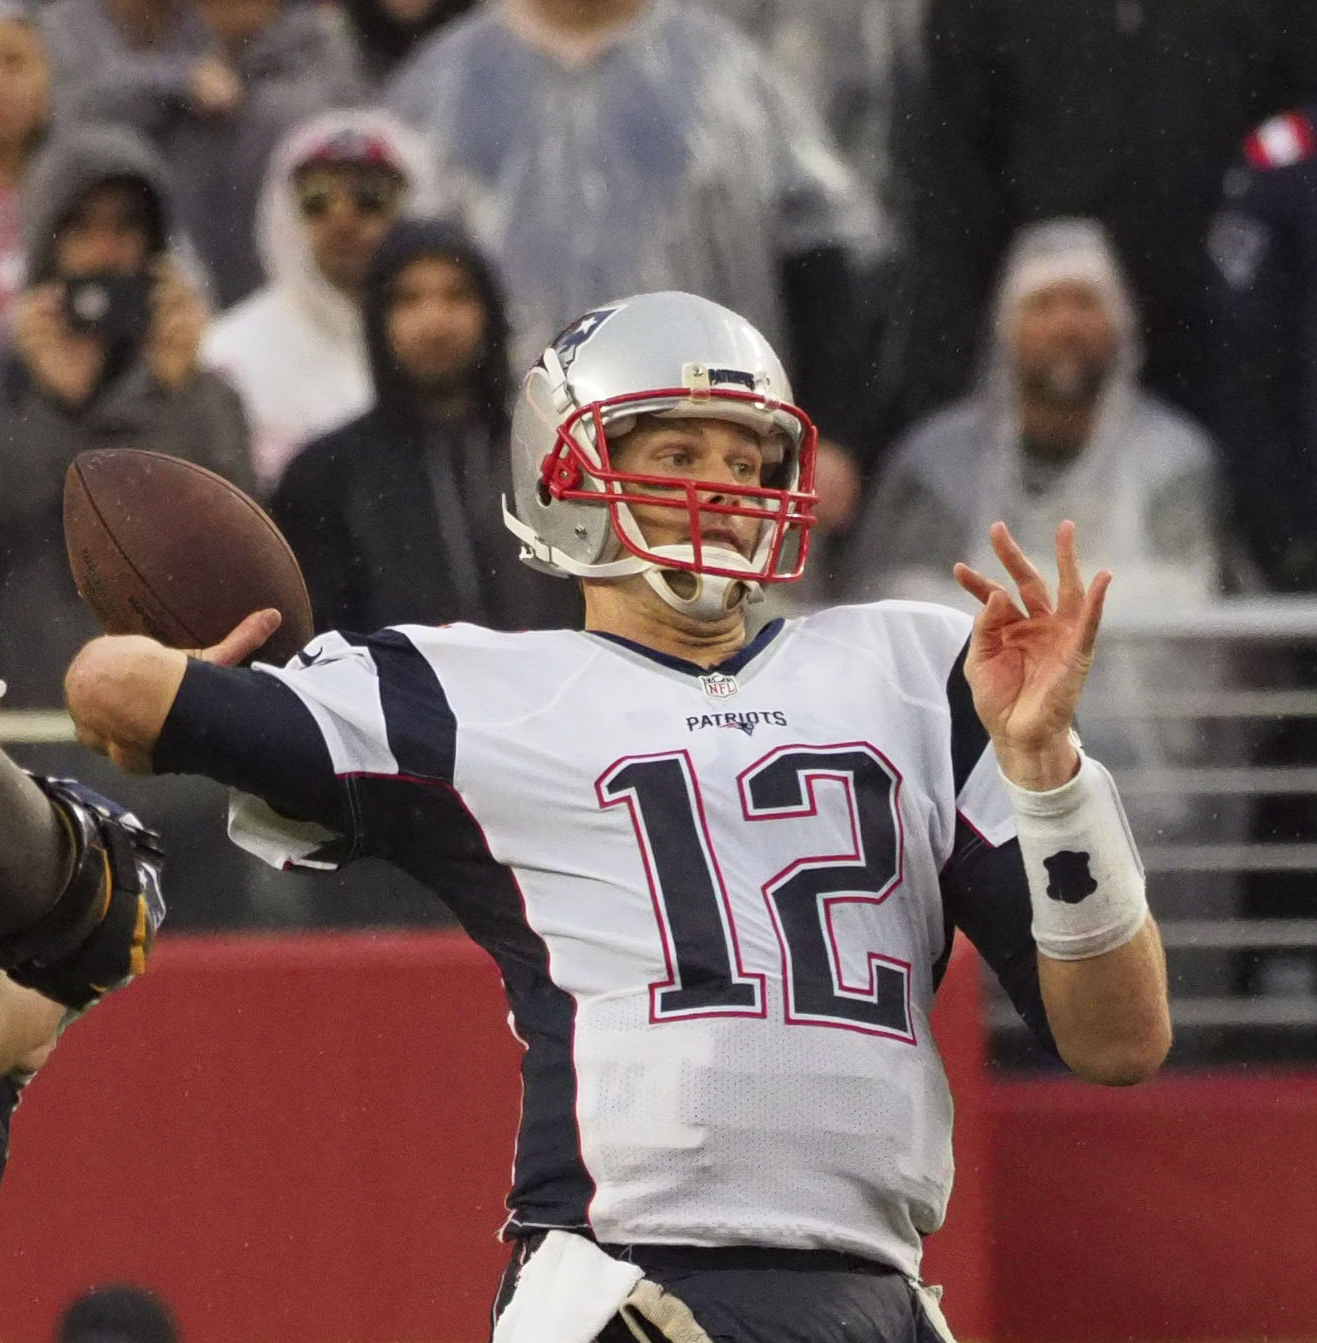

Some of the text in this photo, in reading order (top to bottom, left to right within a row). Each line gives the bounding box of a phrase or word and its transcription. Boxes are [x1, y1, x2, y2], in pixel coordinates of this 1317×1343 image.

[708, 682, 737, 696] NFL
[686, 711, 788, 732] PATRIOTS
[594, 741, 918, 1047] 12
